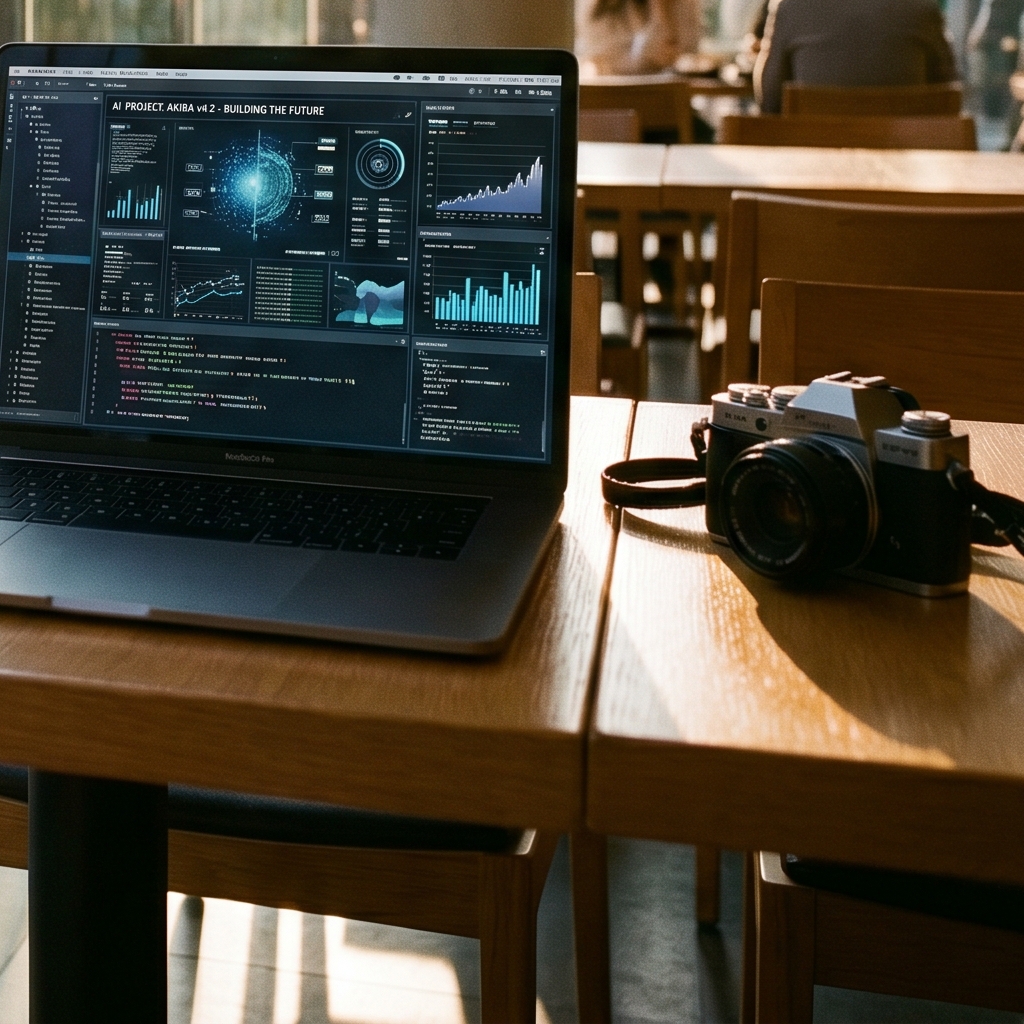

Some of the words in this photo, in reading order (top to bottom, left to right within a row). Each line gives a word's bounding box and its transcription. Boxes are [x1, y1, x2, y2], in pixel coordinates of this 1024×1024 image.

[112, 101, 122, 111] AI
[166, 102, 195, 113] AKIBA
[224, 104, 267, 114] BUILDING
[269, 105, 287, 115] THE
[289, 105, 325, 116] FUTURE
